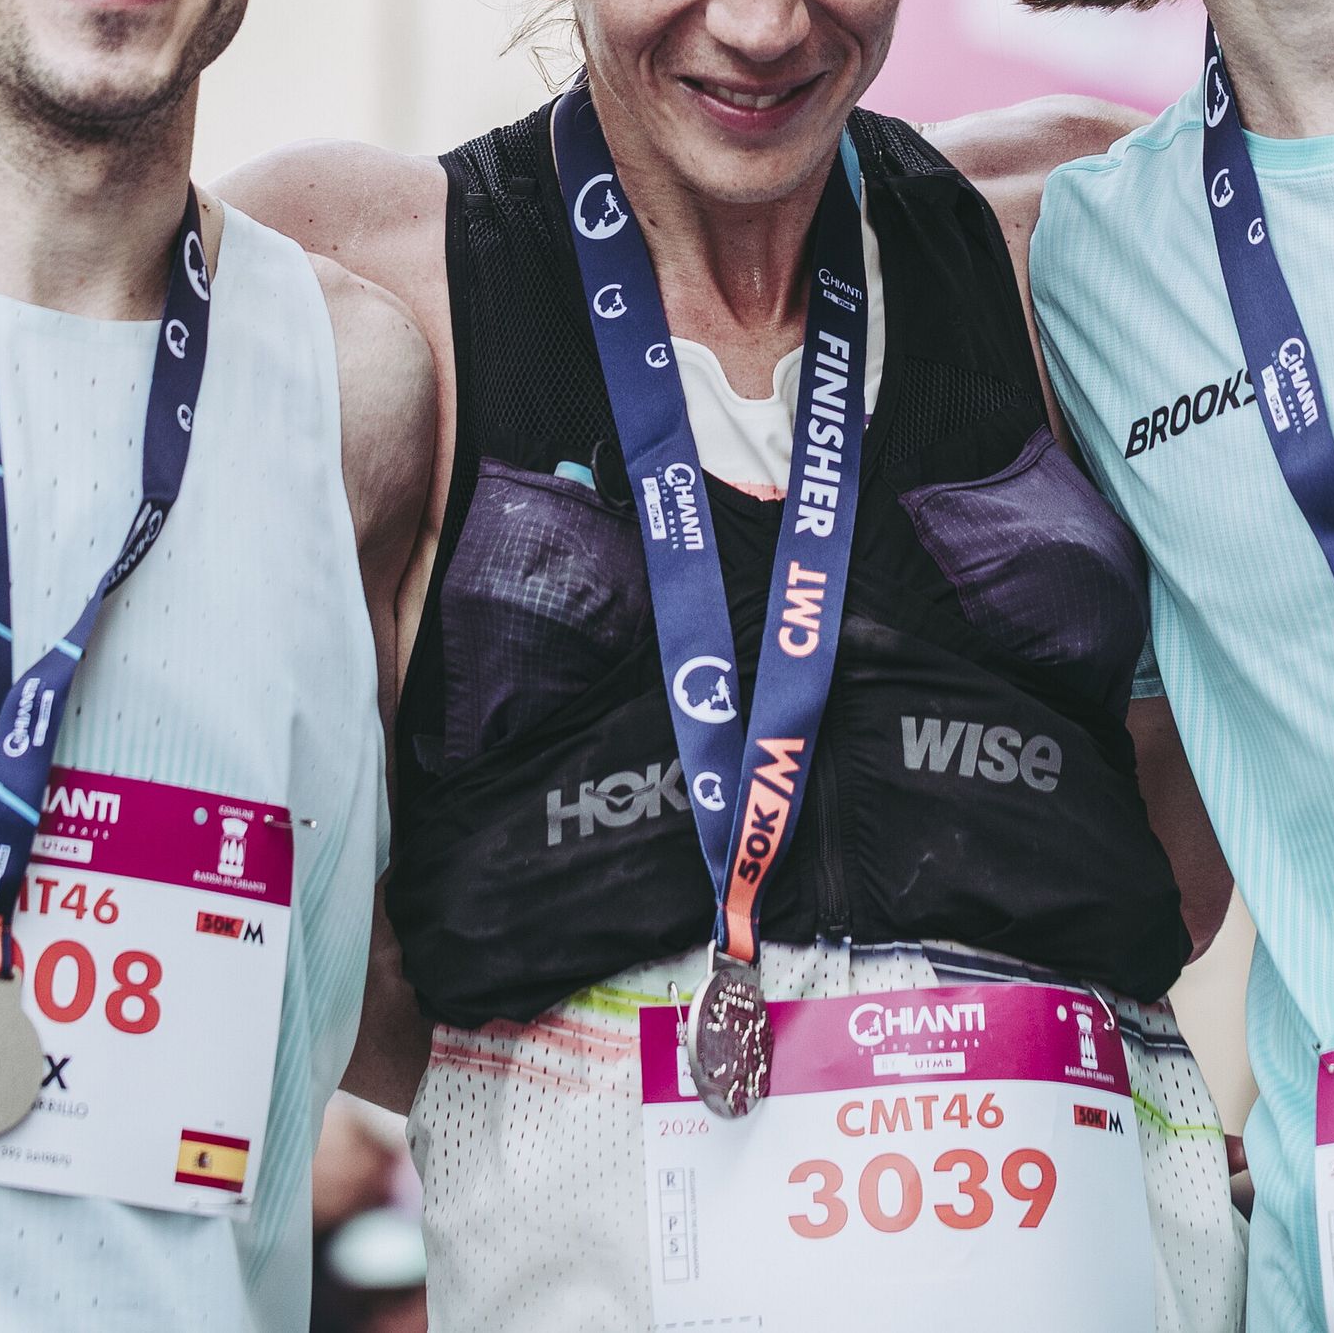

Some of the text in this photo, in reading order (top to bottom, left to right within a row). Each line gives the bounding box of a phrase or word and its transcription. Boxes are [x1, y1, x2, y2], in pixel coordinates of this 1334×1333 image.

[818, 268, 862, 300] CHIANTI
[1278, 337, 1319, 428] CHIANTI
[795, 329, 850, 539] FINISHER
[664, 463, 704, 550] CHIANTI
[778, 562, 828, 658] CMT
[737, 803, 781, 885] 50K
[848, 1002, 987, 1047] CHIANTI
[659, 1117, 709, 1136] 2026
[836, 1092, 1005, 1138] CMT46
[787, 1147, 1058, 1240] 3039
